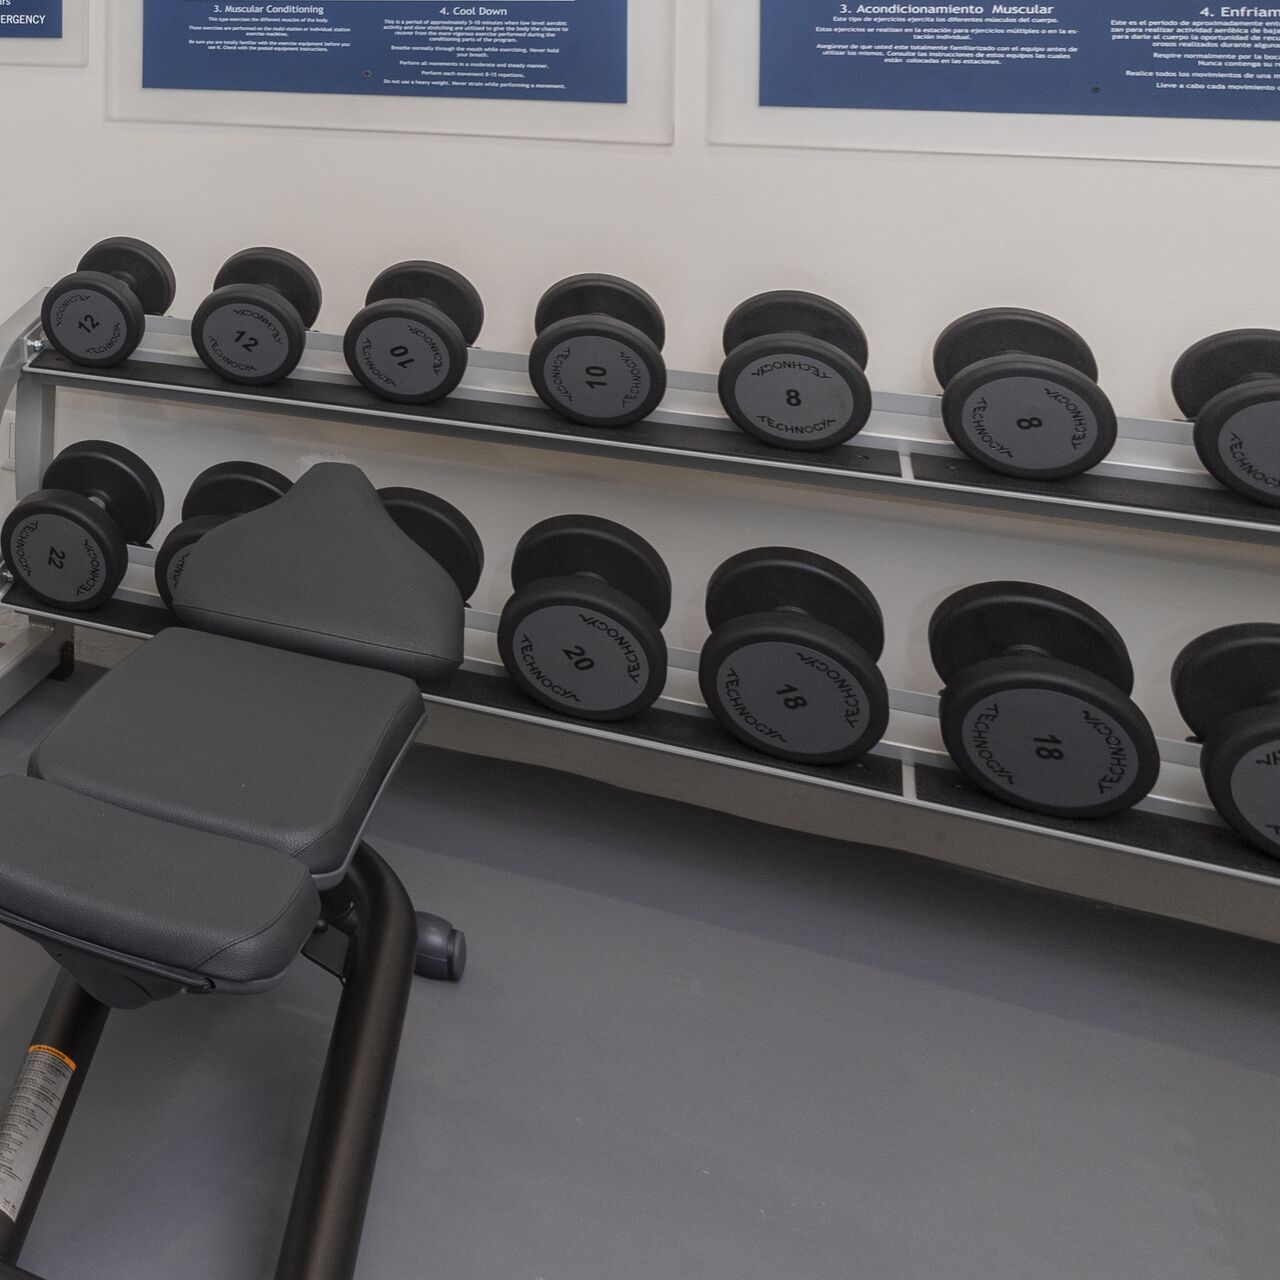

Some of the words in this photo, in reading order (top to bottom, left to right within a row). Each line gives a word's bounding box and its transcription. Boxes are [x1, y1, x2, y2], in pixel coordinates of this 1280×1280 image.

[213, 4, 223, 13] 3.
[224, 4, 265, 13] Muscular
[266, 4, 324, 16] Conditioning
[439, 7, 450, 16] 4.
[452, 6, 476, 16] Cool
[478, 6, 508, 16] Down
[839, 3, 852, 14] 3.
[856, 4, 984, 14] Acondicionamiento
[991, 4, 1055, 15] Muscular
[1199, 7, 1215, 17] 4.
[77, 314, 100, 333] 12
[234, 330, 259, 352] 12
[585, 365, 607, 389] 10
[785, 389, 802, 407] 8
[1016, 416, 1043, 430] 8
[1230, 432, 1280, 488] TECHNOG
[47, 546, 66, 569] 22
[562, 645, 595, 671] 20
[775, 683, 808, 710] 18
[1033, 733, 1065, 761] 18
